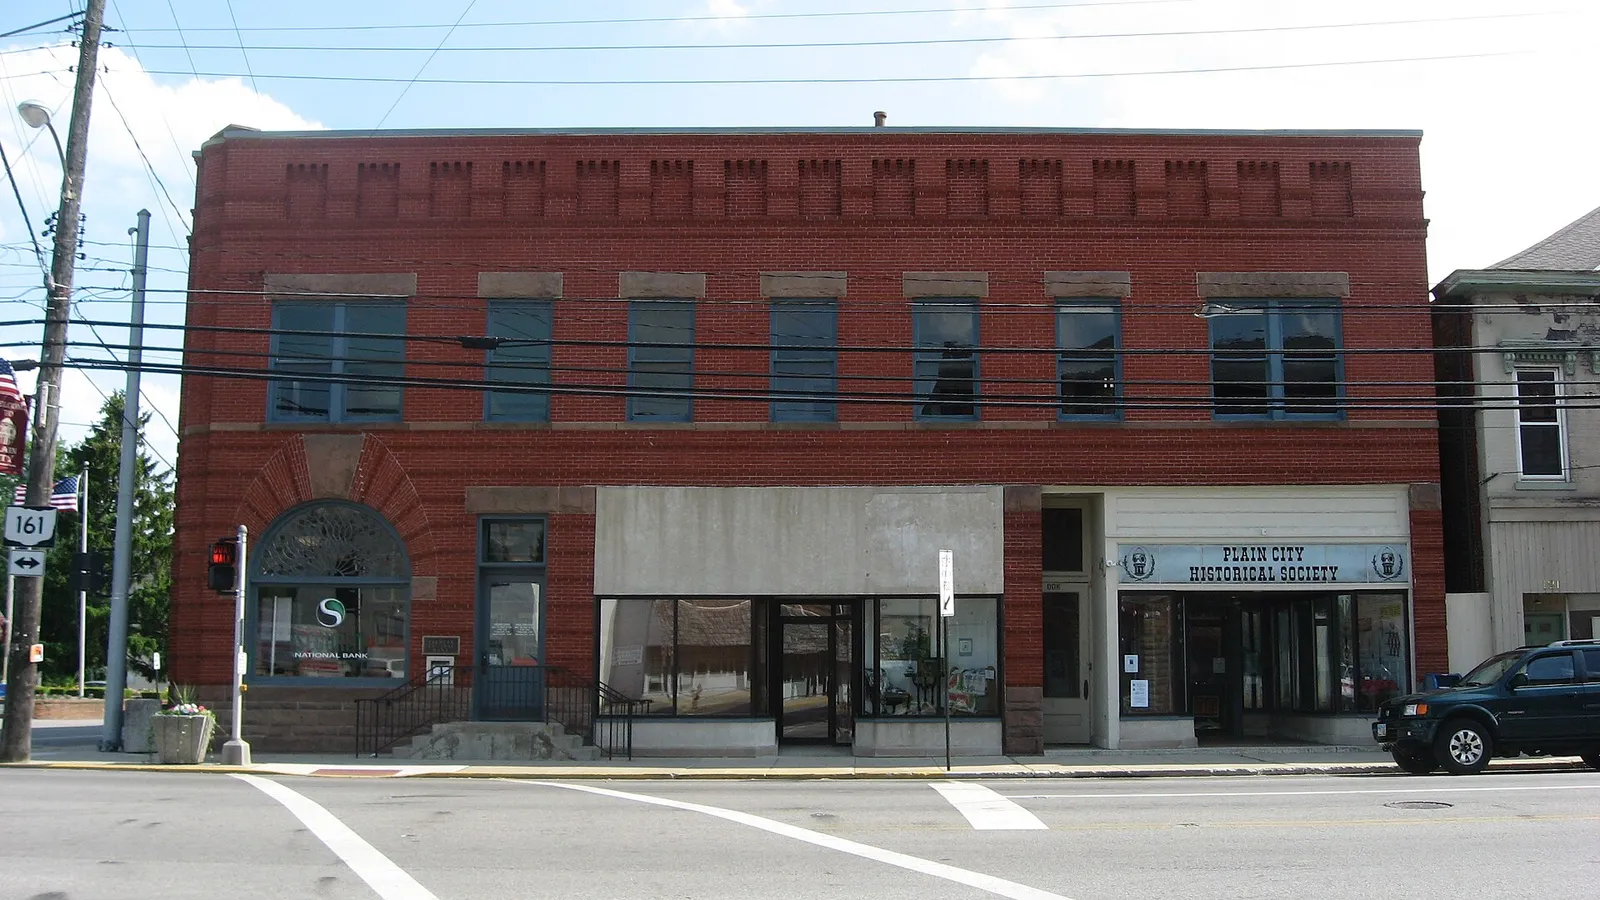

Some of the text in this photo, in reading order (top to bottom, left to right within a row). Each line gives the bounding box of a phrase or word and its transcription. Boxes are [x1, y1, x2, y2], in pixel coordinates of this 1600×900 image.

[17, 515, 43, 534] 161
[1223, 546, 1304, 562] PLAIN CITY
[1189, 566, 1339, 582] HISTORICAL SOCIETY
